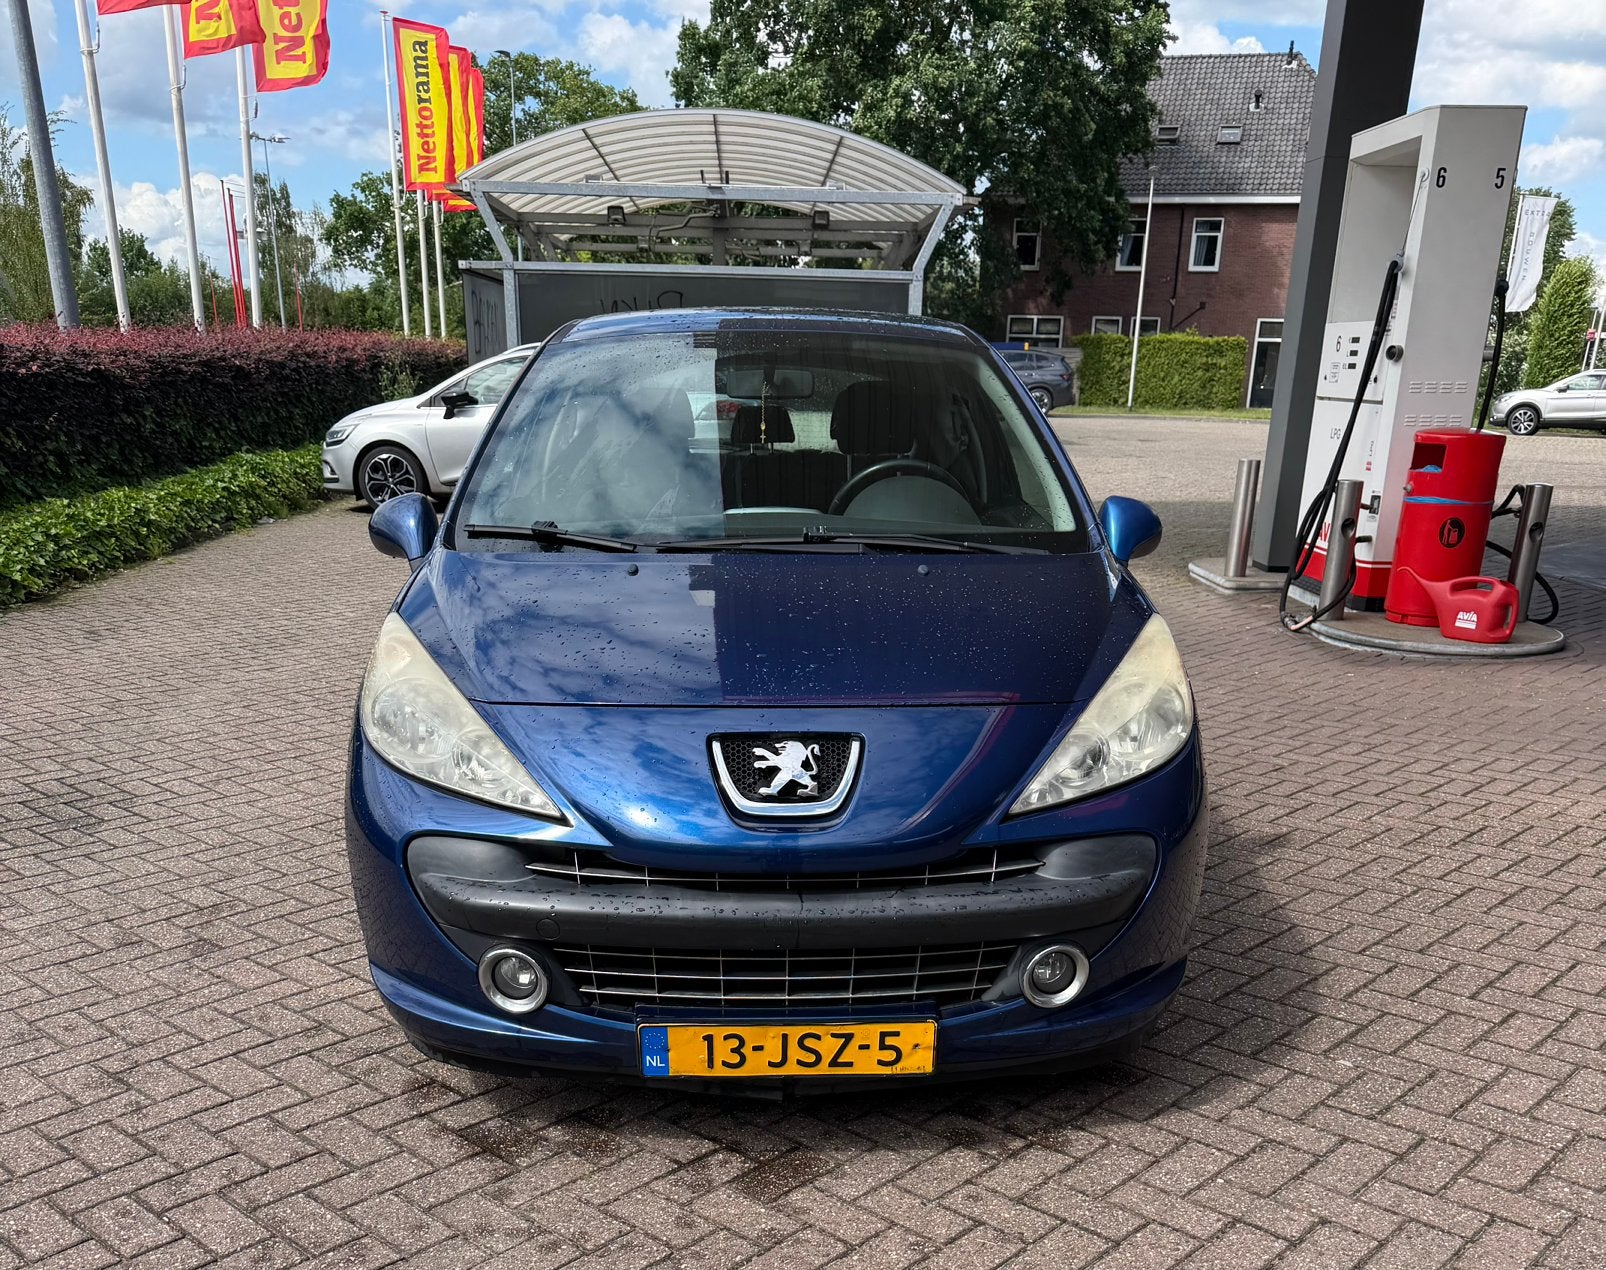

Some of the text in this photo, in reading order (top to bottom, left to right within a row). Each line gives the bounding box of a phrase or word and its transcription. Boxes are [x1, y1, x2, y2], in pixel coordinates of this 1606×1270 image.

[411, 39, 438, 175] Nettorama
[1436, 167, 1506, 189] 6 5
[1336, 335, 1342, 352] 6
[1330, 428, 1342, 440] LPG
[701, 1030, 903, 1070] 13-JSZ-5
[645, 1056, 665, 1067] NL
